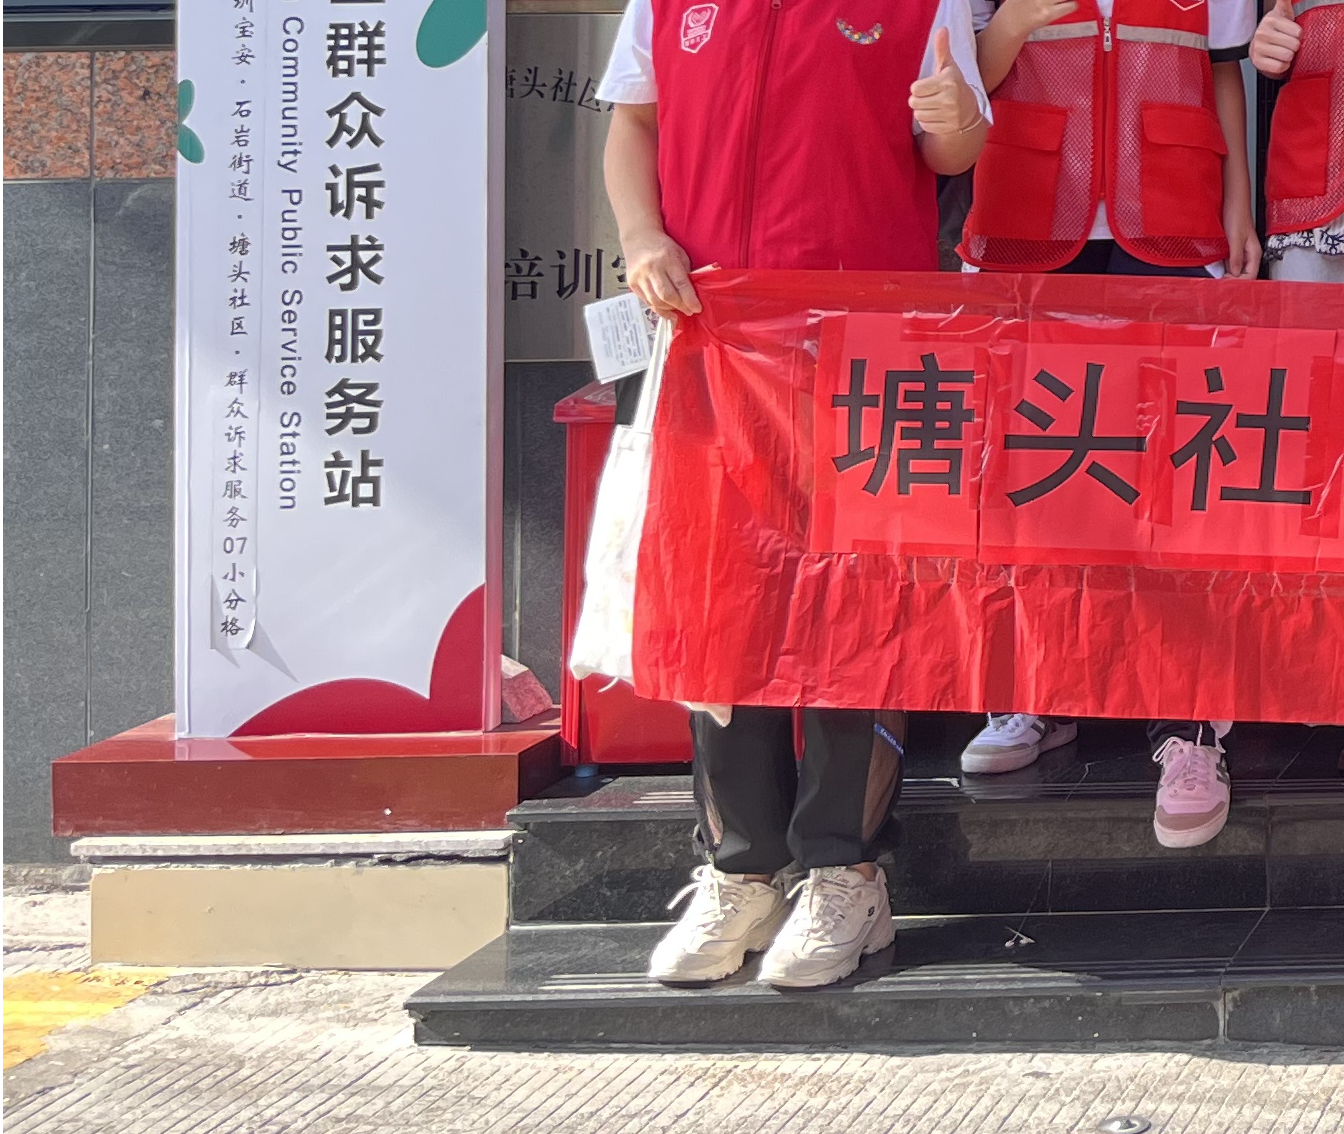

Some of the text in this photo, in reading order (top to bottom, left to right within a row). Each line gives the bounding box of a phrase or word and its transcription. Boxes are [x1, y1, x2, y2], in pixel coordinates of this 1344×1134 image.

[276, 16, 304, 175] Community
[280, 188, 303, 275] Public
[280, 289, 303, 396] Service
[279, 410, 302, 511] Station
